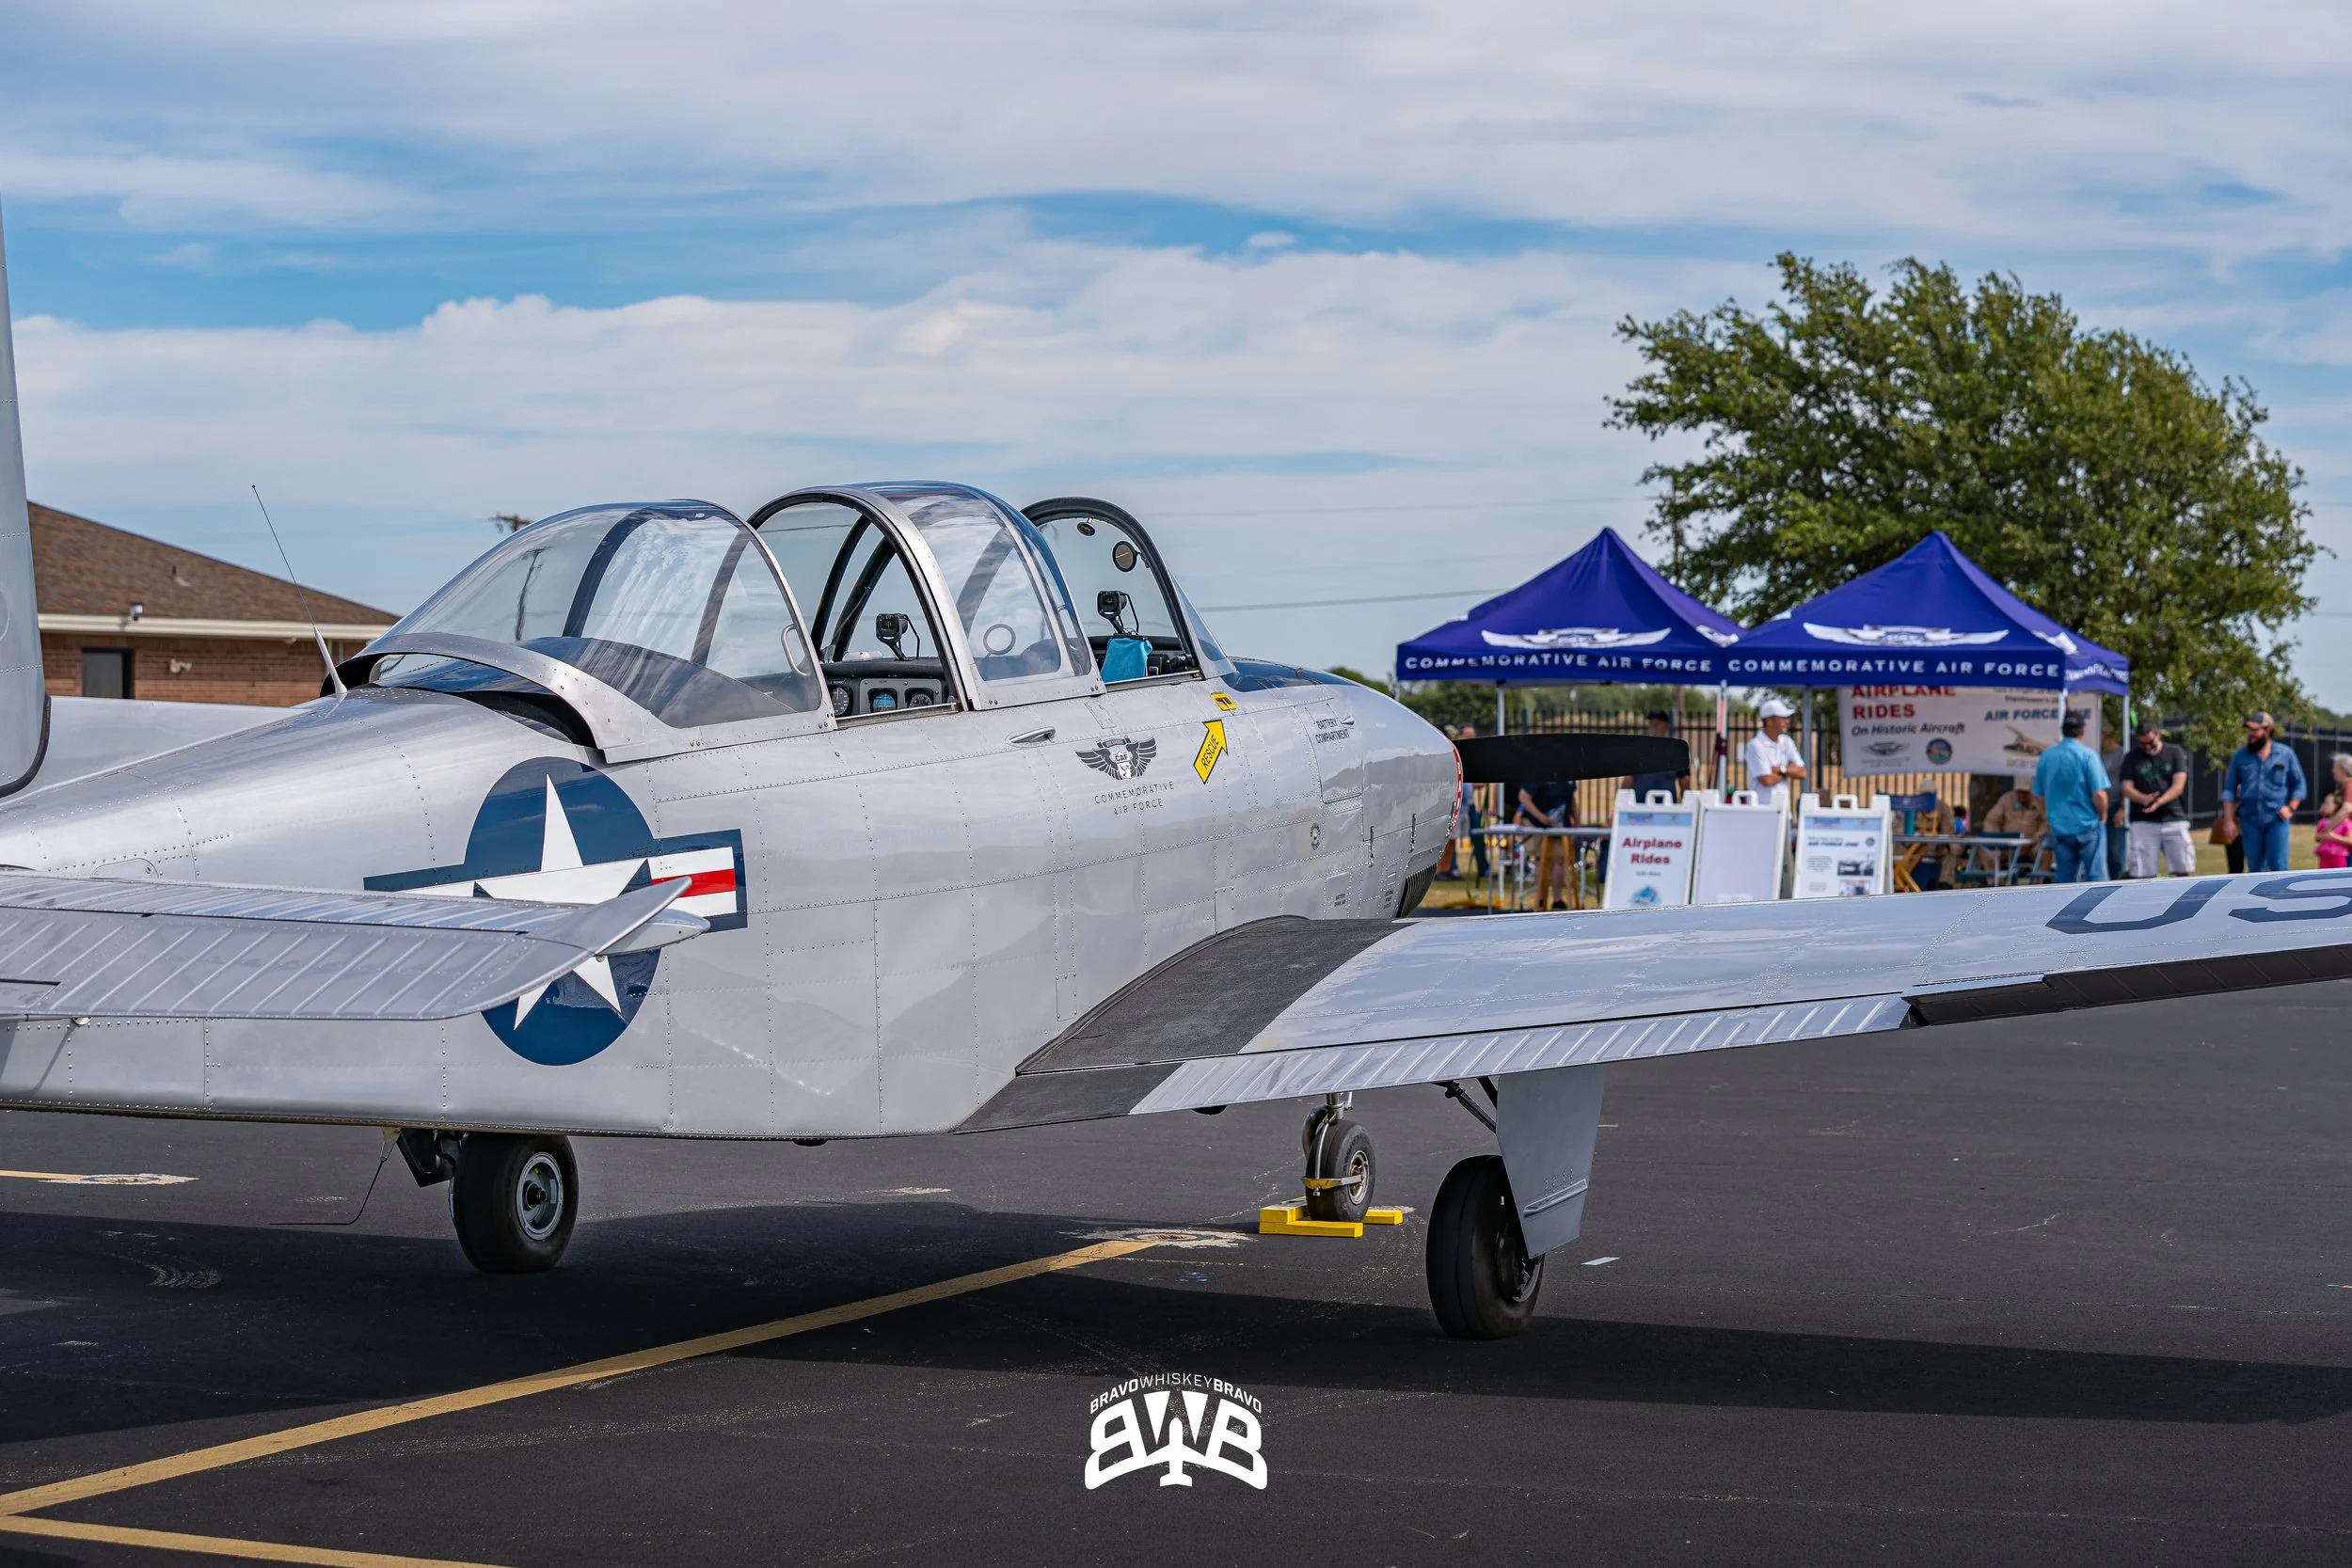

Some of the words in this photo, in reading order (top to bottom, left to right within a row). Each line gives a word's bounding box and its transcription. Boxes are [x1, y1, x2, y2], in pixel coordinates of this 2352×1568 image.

[1405, 654, 1589, 670] COMMEMORATIVE
[1597, 656, 1632, 669] AIR
[1642, 657, 1712, 673] FORCE
[1727, 658, 1926, 673] COMMEMORATIVE
[1935, 660, 1974, 674] AIR
[1984, 662, 2059, 677] FORCE
[1851, 704, 1915, 720] RIDES
[1984, 709, 2010, 721] AIR
[2012, 707, 2058, 721] FORCE
[1316, 718, 1338, 730] BATTERY
[1851, 725, 1869, 736] On
[1870, 723, 1917, 736] Historic
[1920, 722, 1965, 736] Aircraft
[1115, 753, 1128, 762] CAF
[1200, 734, 1219, 769] RESCUE
[1094, 781, 1175, 804] COMMEMORATIVE
[1114, 804, 1129, 816] AIR
[1133, 798, 1164, 812] FORCE
[1622, 836, 1683, 850] Airplane
[1630, 853, 1671, 865] Rides
